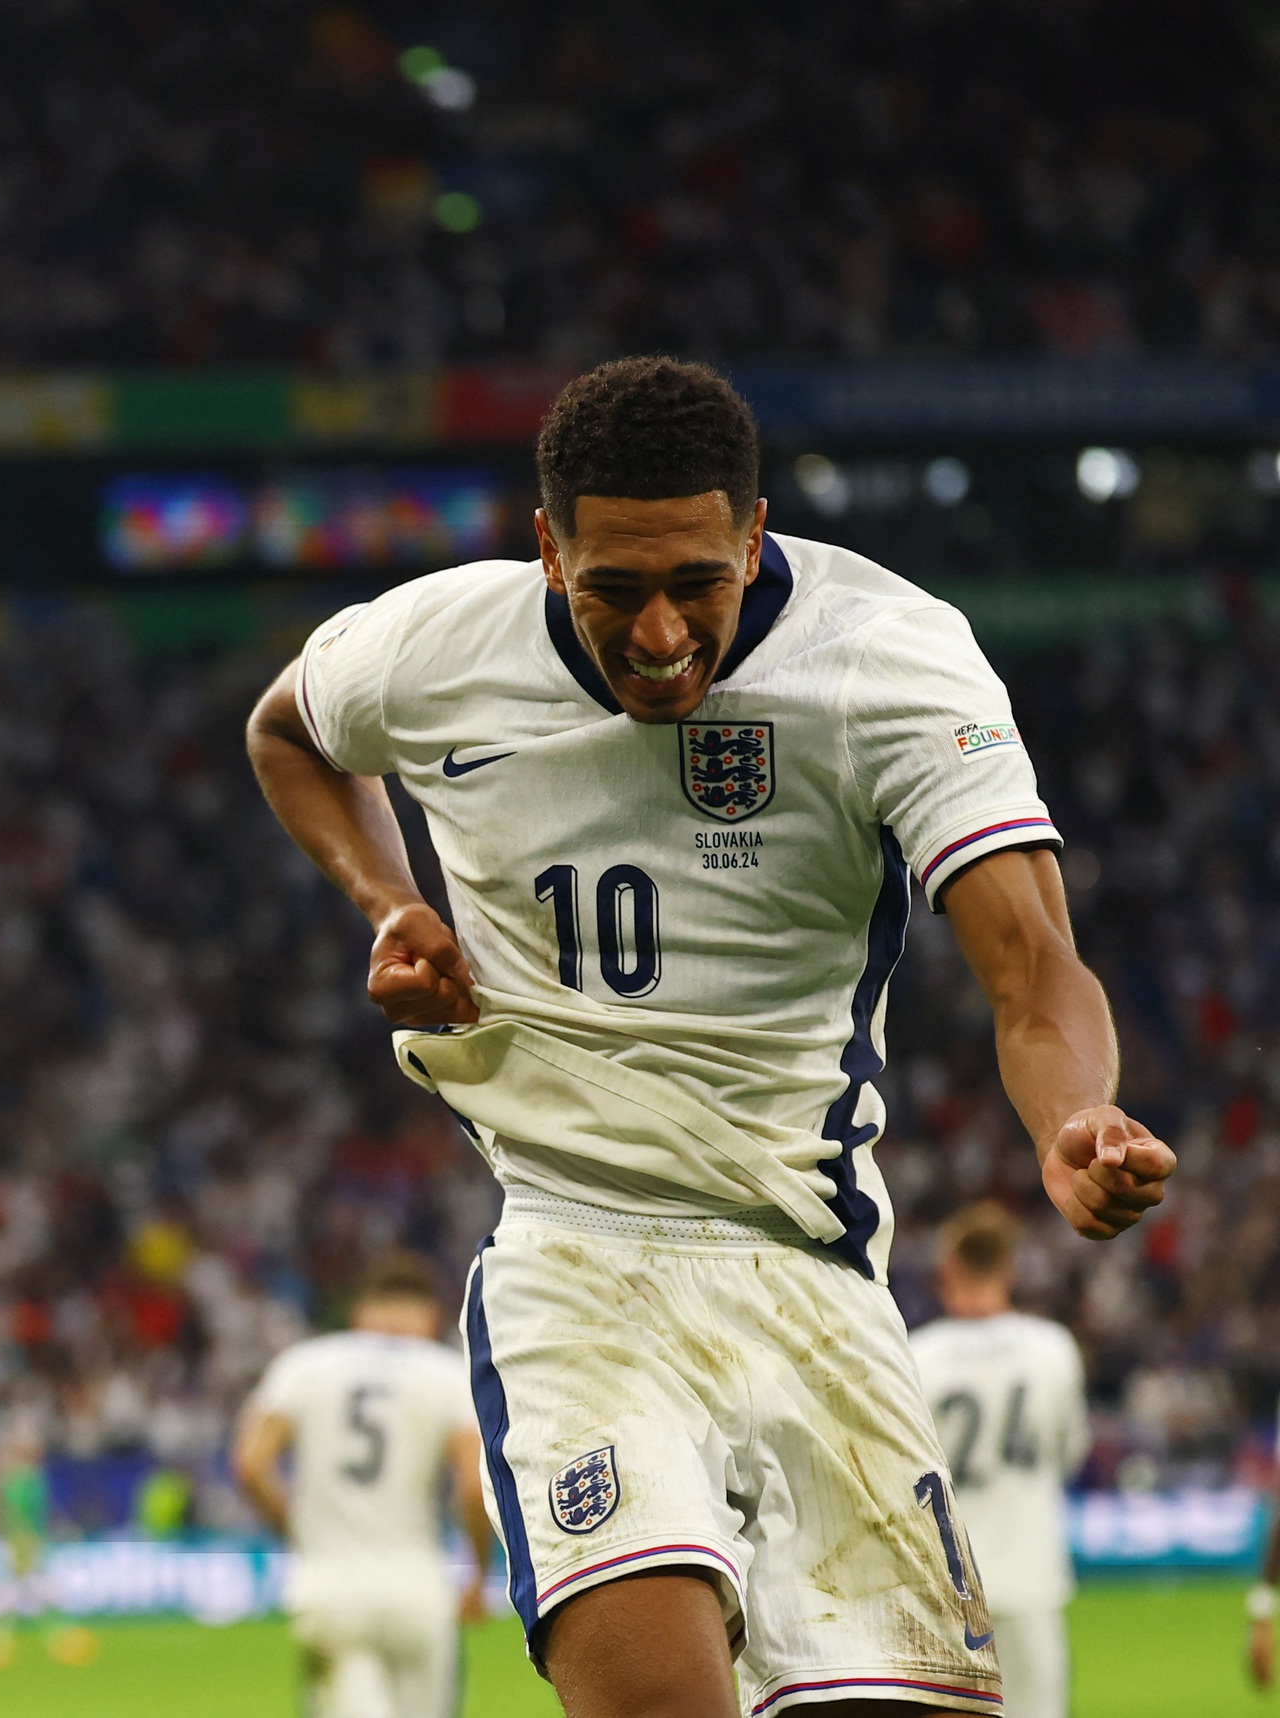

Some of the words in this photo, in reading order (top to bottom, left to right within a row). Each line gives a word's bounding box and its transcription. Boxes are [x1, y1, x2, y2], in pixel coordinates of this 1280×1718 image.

[954, 724, 979, 737] UEFA
[695, 831, 764, 849] SLOVAKIA
[702, 852, 759, 869] 30.06.24
[535, 864, 661, 998] 10
[341, 1381, 399, 1488] 5
[933, 1378, 1039, 1489] 24
[913, 1471, 984, 1600] 1
